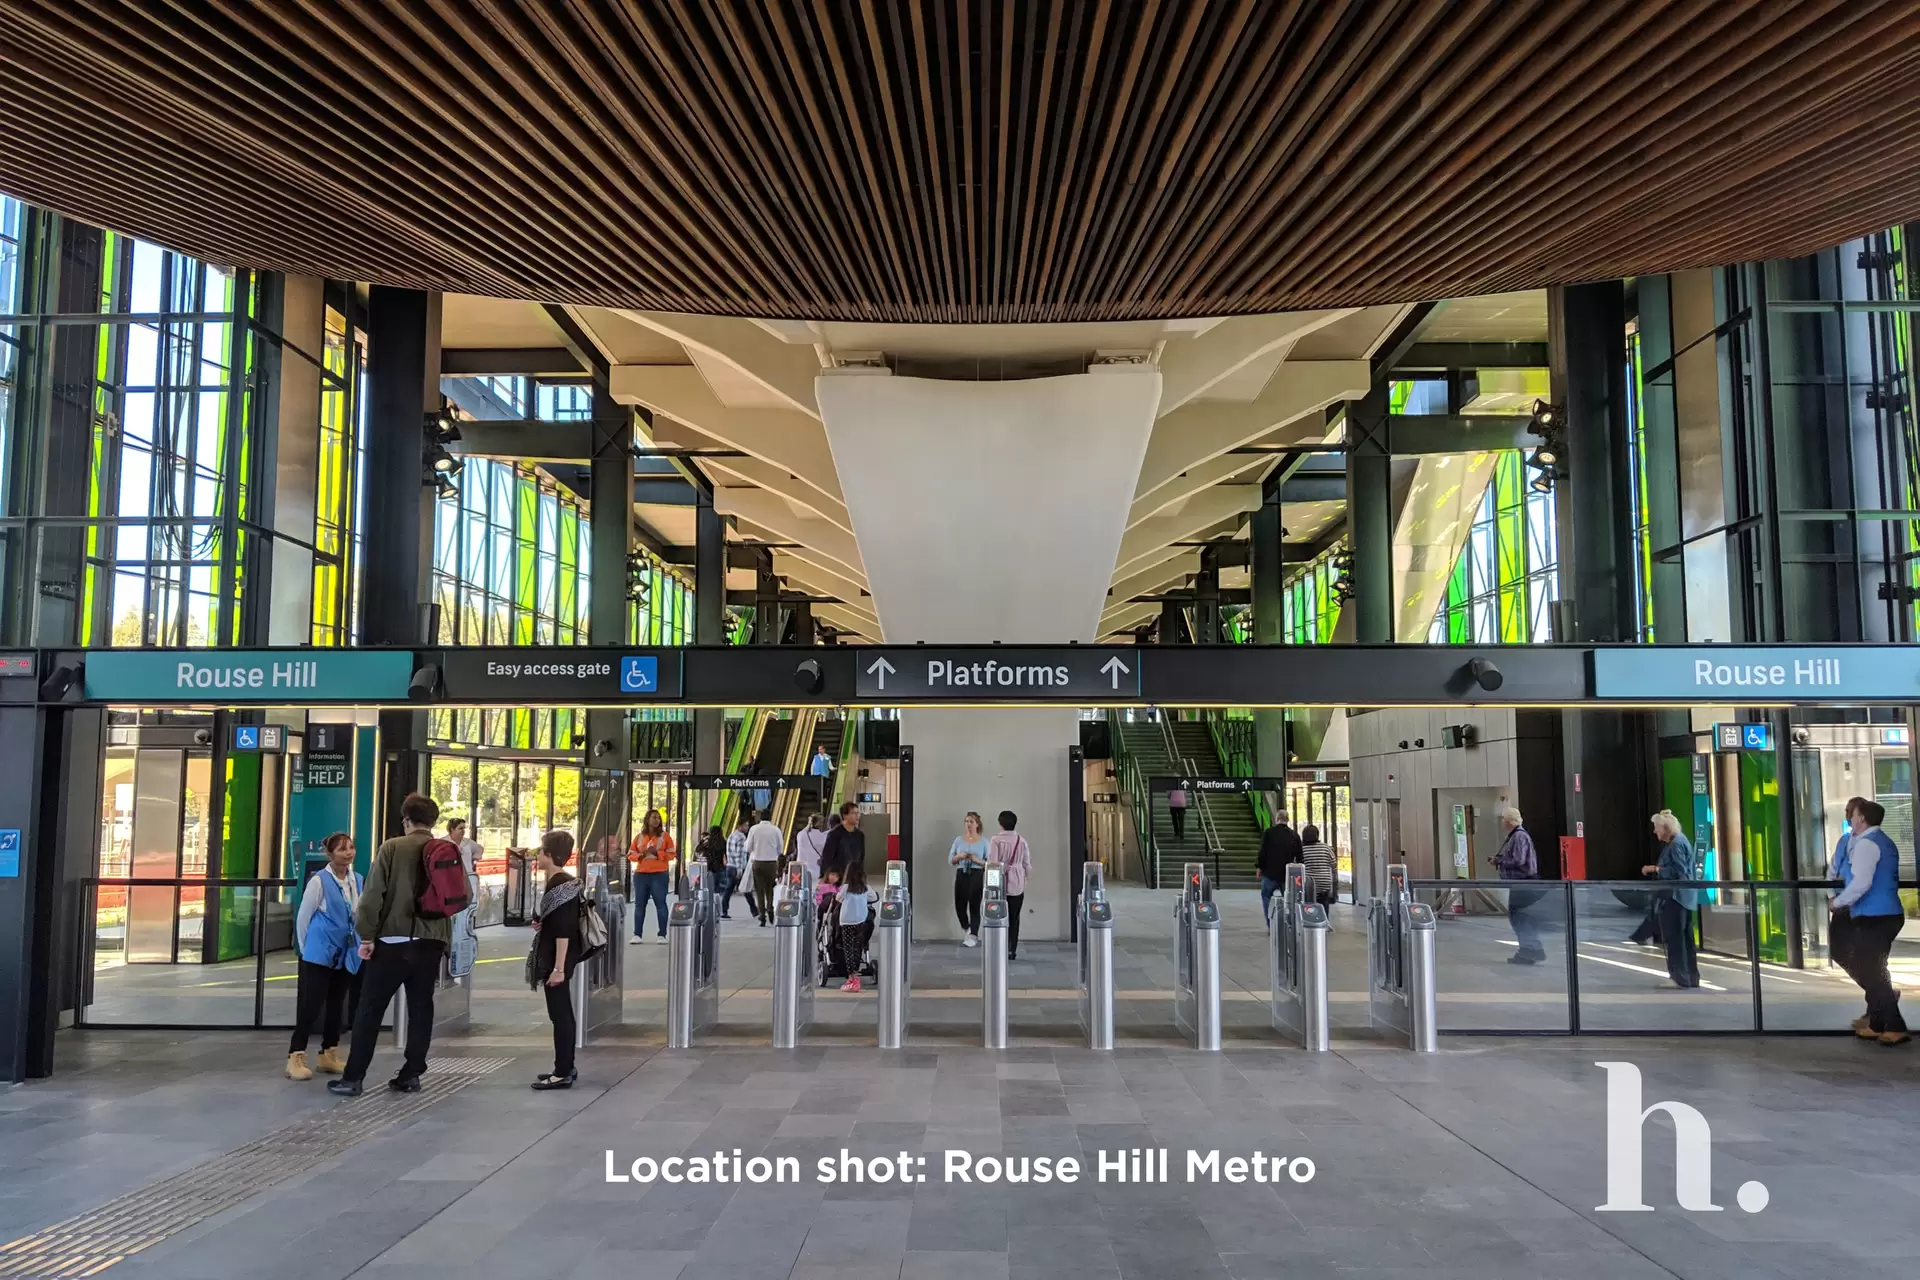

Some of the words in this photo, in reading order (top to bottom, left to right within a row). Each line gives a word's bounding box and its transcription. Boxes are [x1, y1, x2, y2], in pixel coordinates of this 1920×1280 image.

[177, 662, 264, 688] Rouse
[272, 661, 317, 688] Hill
[487, 661, 522, 679] Easy
[523, 664, 575, 676] access
[577, 662, 611, 679] gate
[928, 660, 1070, 686] Platforms
[1695, 659, 1786, 685] Rouse
[1794, 659, 1841, 685] Hill
[308, 763, 346, 772] Emergency
[308, 771, 345, 785] HELP
[730, 778, 770, 787] Platforms
[1196, 780, 1236, 789] Platforms
